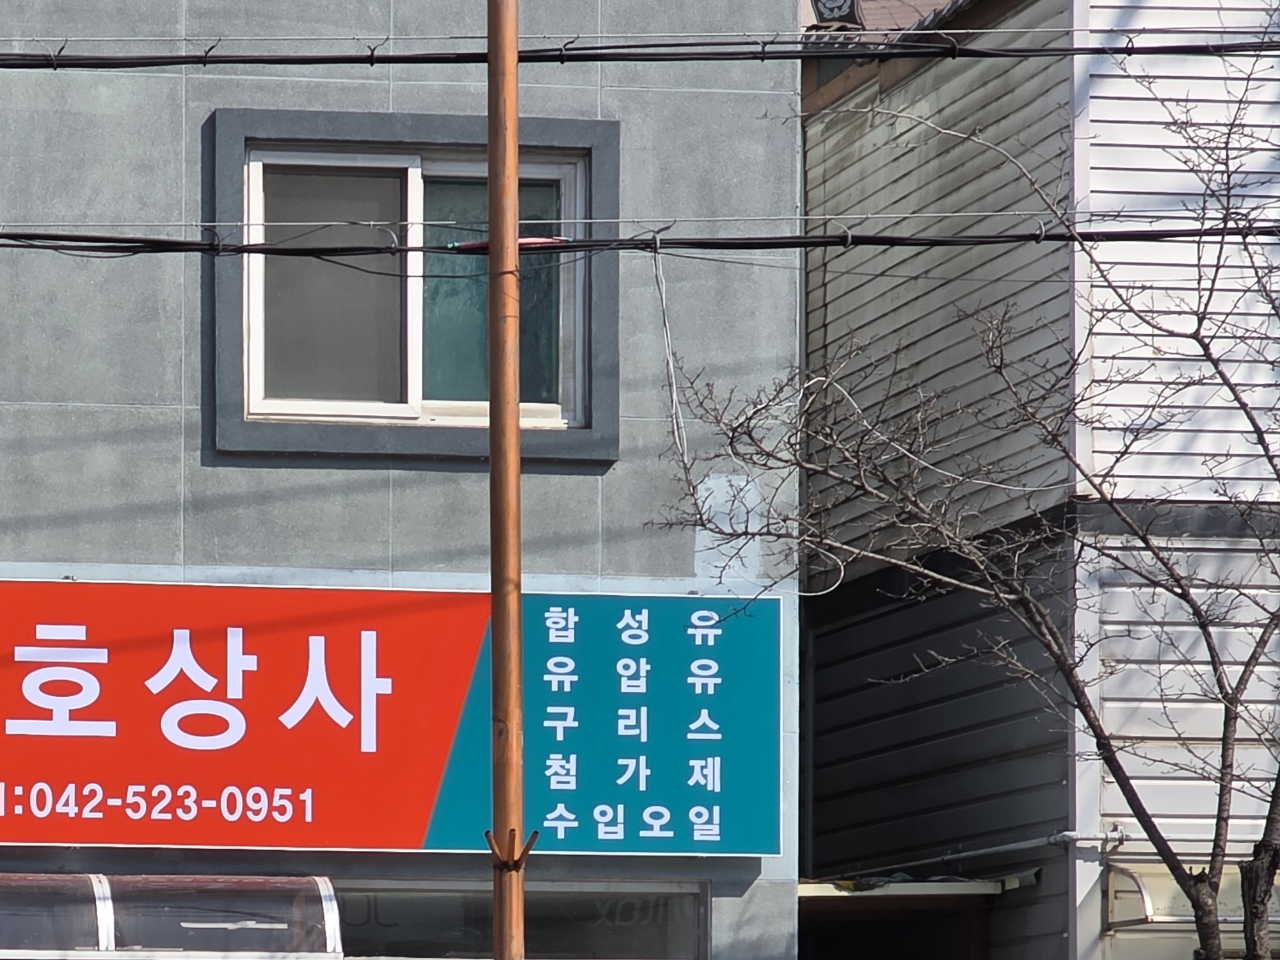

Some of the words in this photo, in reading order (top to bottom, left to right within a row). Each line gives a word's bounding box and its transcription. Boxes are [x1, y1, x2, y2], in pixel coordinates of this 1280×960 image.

[544, 607, 722, 645] 합성유
[543, 656, 722, 694] 유압유
[543, 706, 722, 742] 구리스
[544, 754, 721, 792] 첨가제
[543, 803, 721, 841] 수입오일
